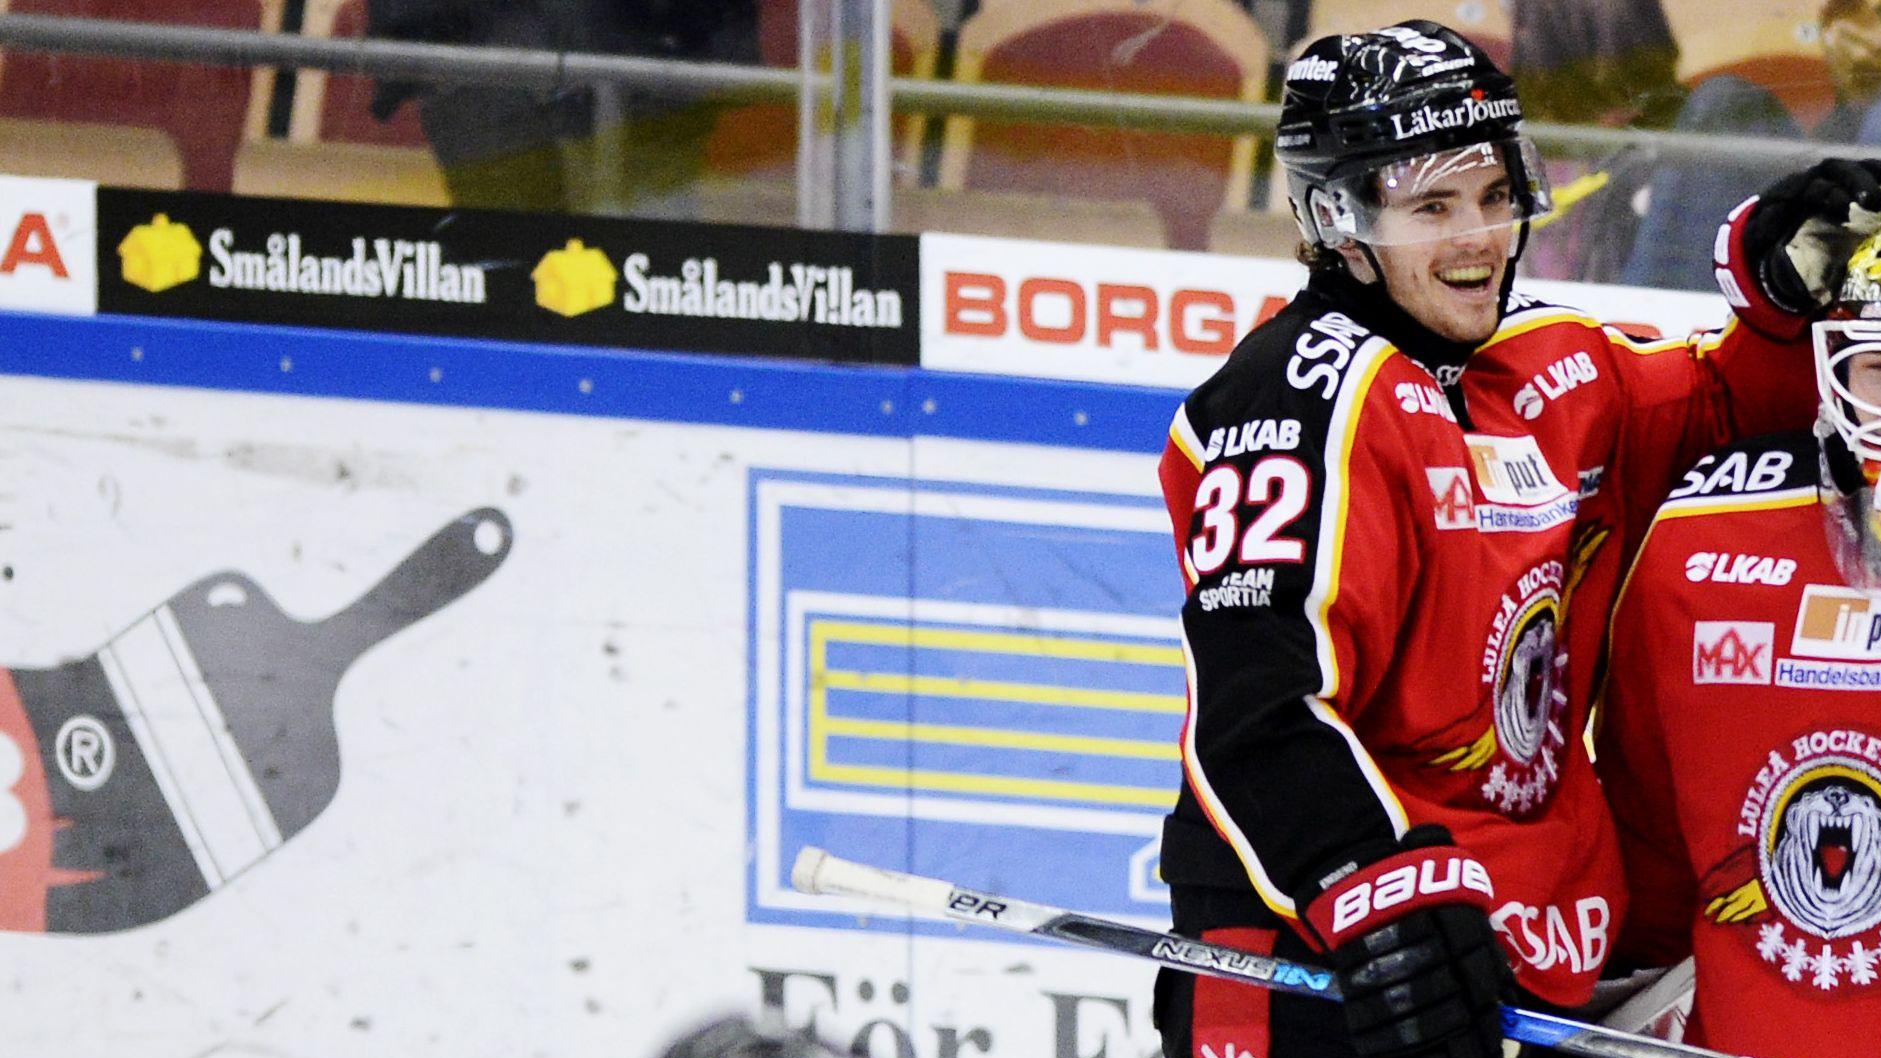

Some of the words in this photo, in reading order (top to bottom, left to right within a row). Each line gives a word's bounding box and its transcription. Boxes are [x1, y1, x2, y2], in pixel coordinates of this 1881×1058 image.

[209, 230, 487, 305] SmålandsVillan
[622, 254, 903, 329] SmålandsVillan
[1538, 350, 1598, 400] LKAB
[1224, 419, 1301, 457] LKAB
[1192, 456, 1309, 574] 32
[1712, 553, 1797, 586] LKAB
[1697, 627, 1767, 680] MAX
[1332, 857, 1494, 934] BAUE
